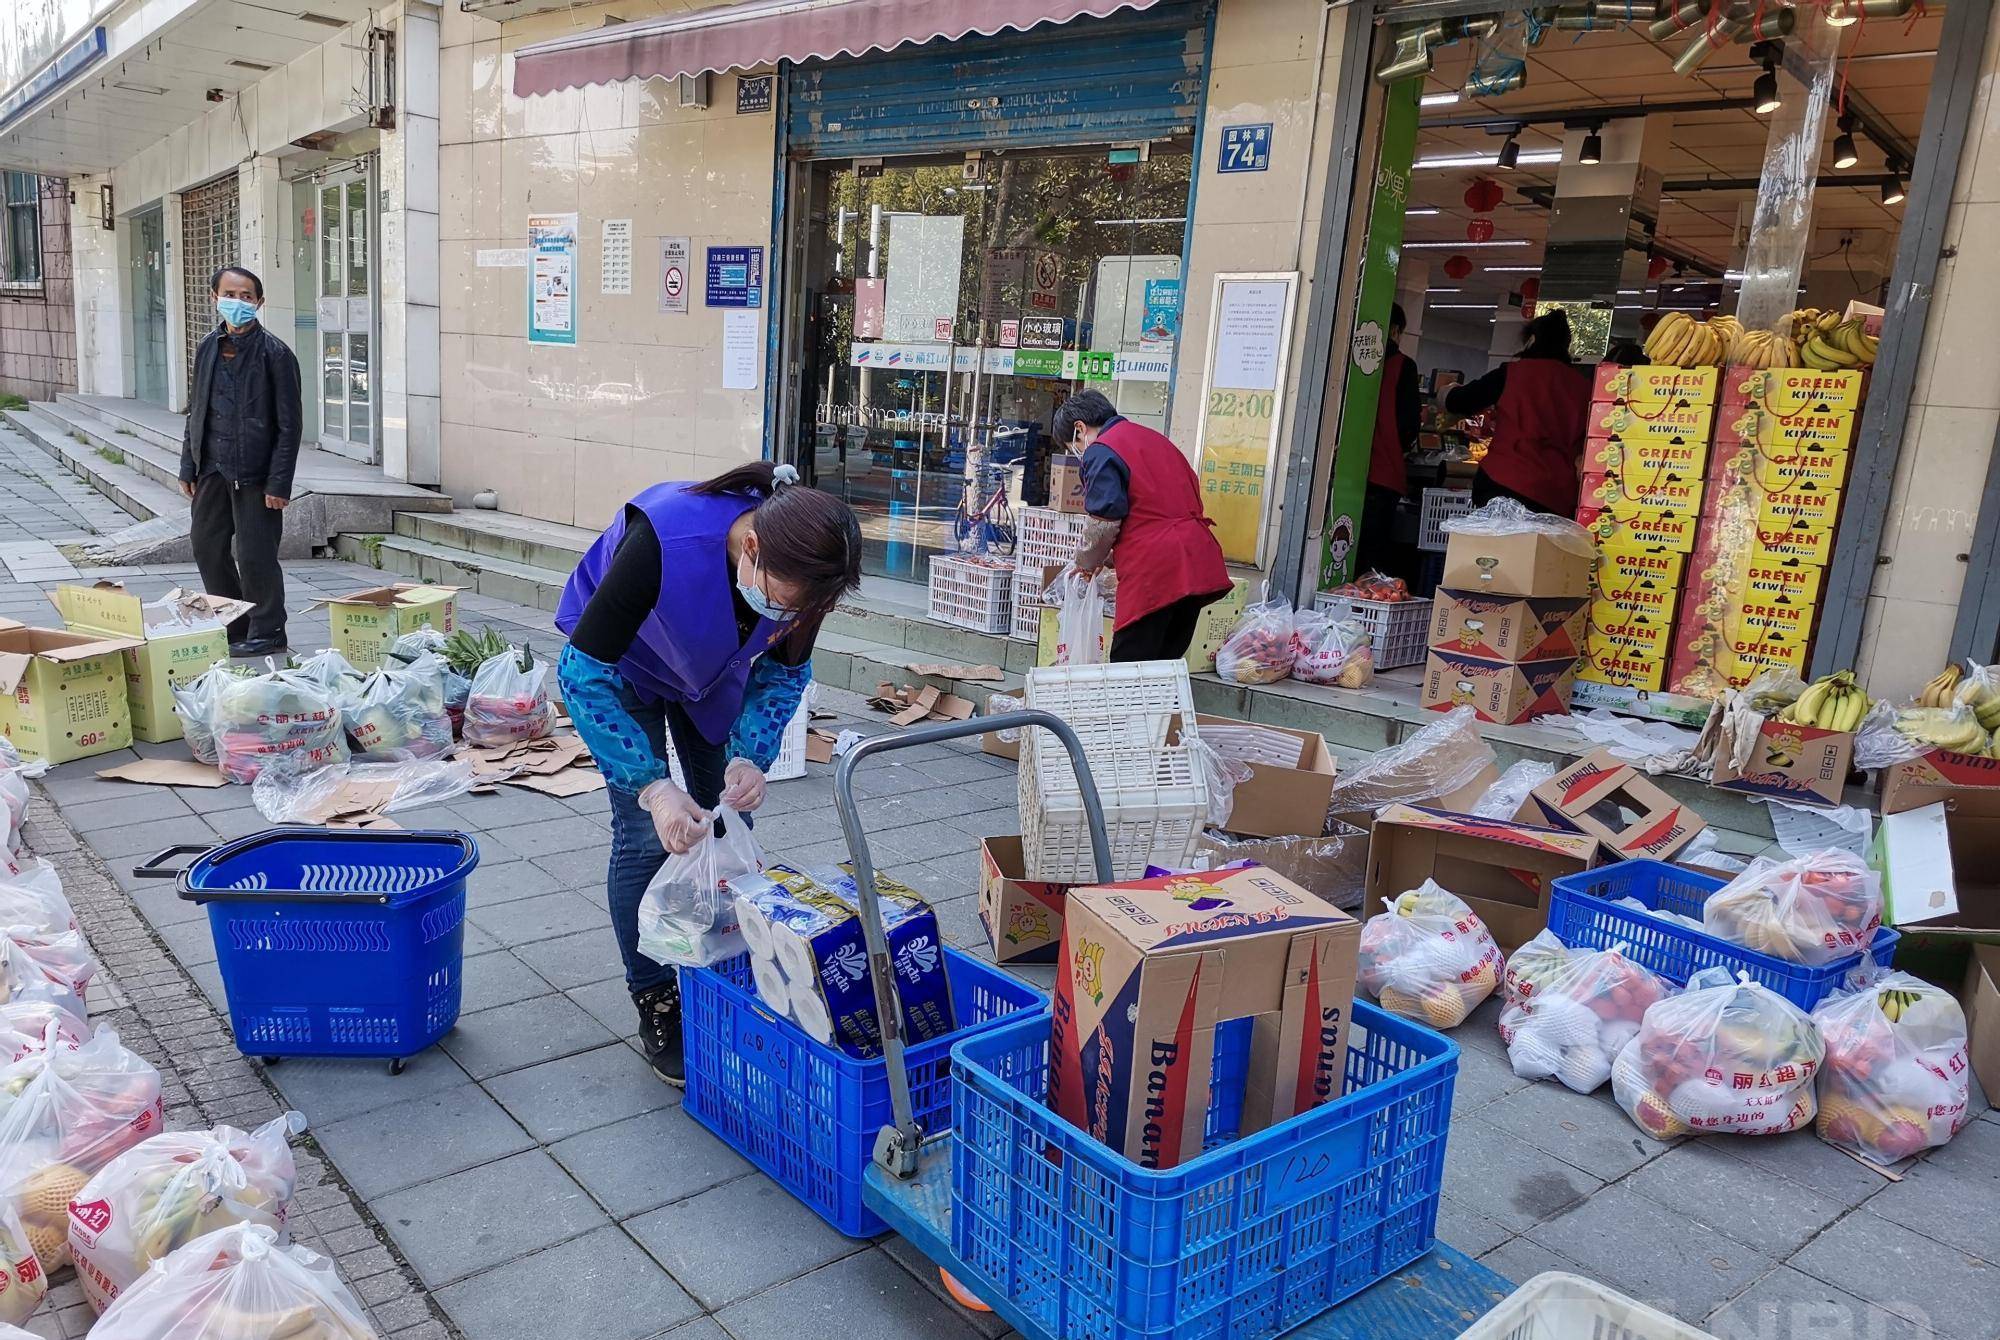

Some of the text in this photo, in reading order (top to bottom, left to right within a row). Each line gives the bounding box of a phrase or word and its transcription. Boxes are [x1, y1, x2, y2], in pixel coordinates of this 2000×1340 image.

[1228, 128, 1265, 142] 园林路
[1227, 143, 1255, 167] 74
[1024, 322, 1061, 334] 小心玻璃
[937, 354, 968, 365] LIHNG
[1128, 362, 1169, 373] LIHONG
[1649, 374, 1704, 386] GREEN
[1786, 377, 1848, 389] GREEN
[1654, 387, 1685, 397] KIWI
[1792, 390, 1824, 400] KIWI
[1209, 393, 1274, 418] 22:00
[1644, 411, 1699, 424] GREEN
[1779, 416, 1841, 429] GREEN
[1648, 424, 1680, 434] KIWI
[1785, 429, 1817, 439] KIWI
[1638, 447, 1693, 460] GREEN
[1643, 460, 1674, 470] KIWI
[1774, 454, 1834, 468] GREEN
[1204, 460, 1266, 479] 周一至周日
[1778, 467, 1811, 477] KIWI
[1206, 479, 1259, 496] 全年无休
[1636, 485, 1690, 498] GREEN
[1641, 497, 1671, 507] KIWI
[1767, 493, 1827, 507] GREEN
[1771, 506, 1804, 516] KIWI
[1630, 520, 1684, 533] GREEN
[1634, 532, 1664, 542] KIWI
[1761, 531, 1819, 545] GREEN
[1764, 543, 1796, 554] KIWI
[1616, 555, 1669, 569] GREEN
[1620, 567, 1650, 578] KIWI
[1749, 568, 1806, 583] GREEN
[1752, 581, 1784, 591] KIWI
[1611, 589, 1664, 604] GREEN
[1615, 601, 1645, 612] KIWI
[1742, 604, 1801, 620] GREEN
[1747, 617, 1778, 628] KIWI
[1605, 624, 1657, 639] GREEN
[1609, 635, 1639, 647] KIWI
[1735, 641, 1793, 658] GREEN
[1600, 657, 1652, 673] GREEN
[1739, 654, 1771, 665] KIWI
[1604, 669, 1633, 680] KIWI
[80, 732, 97, 746] 60
[1560, 761, 1601, 793] Bananas
[1641, 823, 1687, 856] Bananas
[897, 945, 921, 984] Vinda
[823, 954, 850, 993] Vinda
[923, 1001, 947, 1036] 蓝色经
[1313, 1006, 1341, 1109] anas
[1142, 1038, 1179, 1169] Banan
[1690, 1111, 1764, 1127] 做您身边的
[1278, 1153, 1330, 1190] 120
